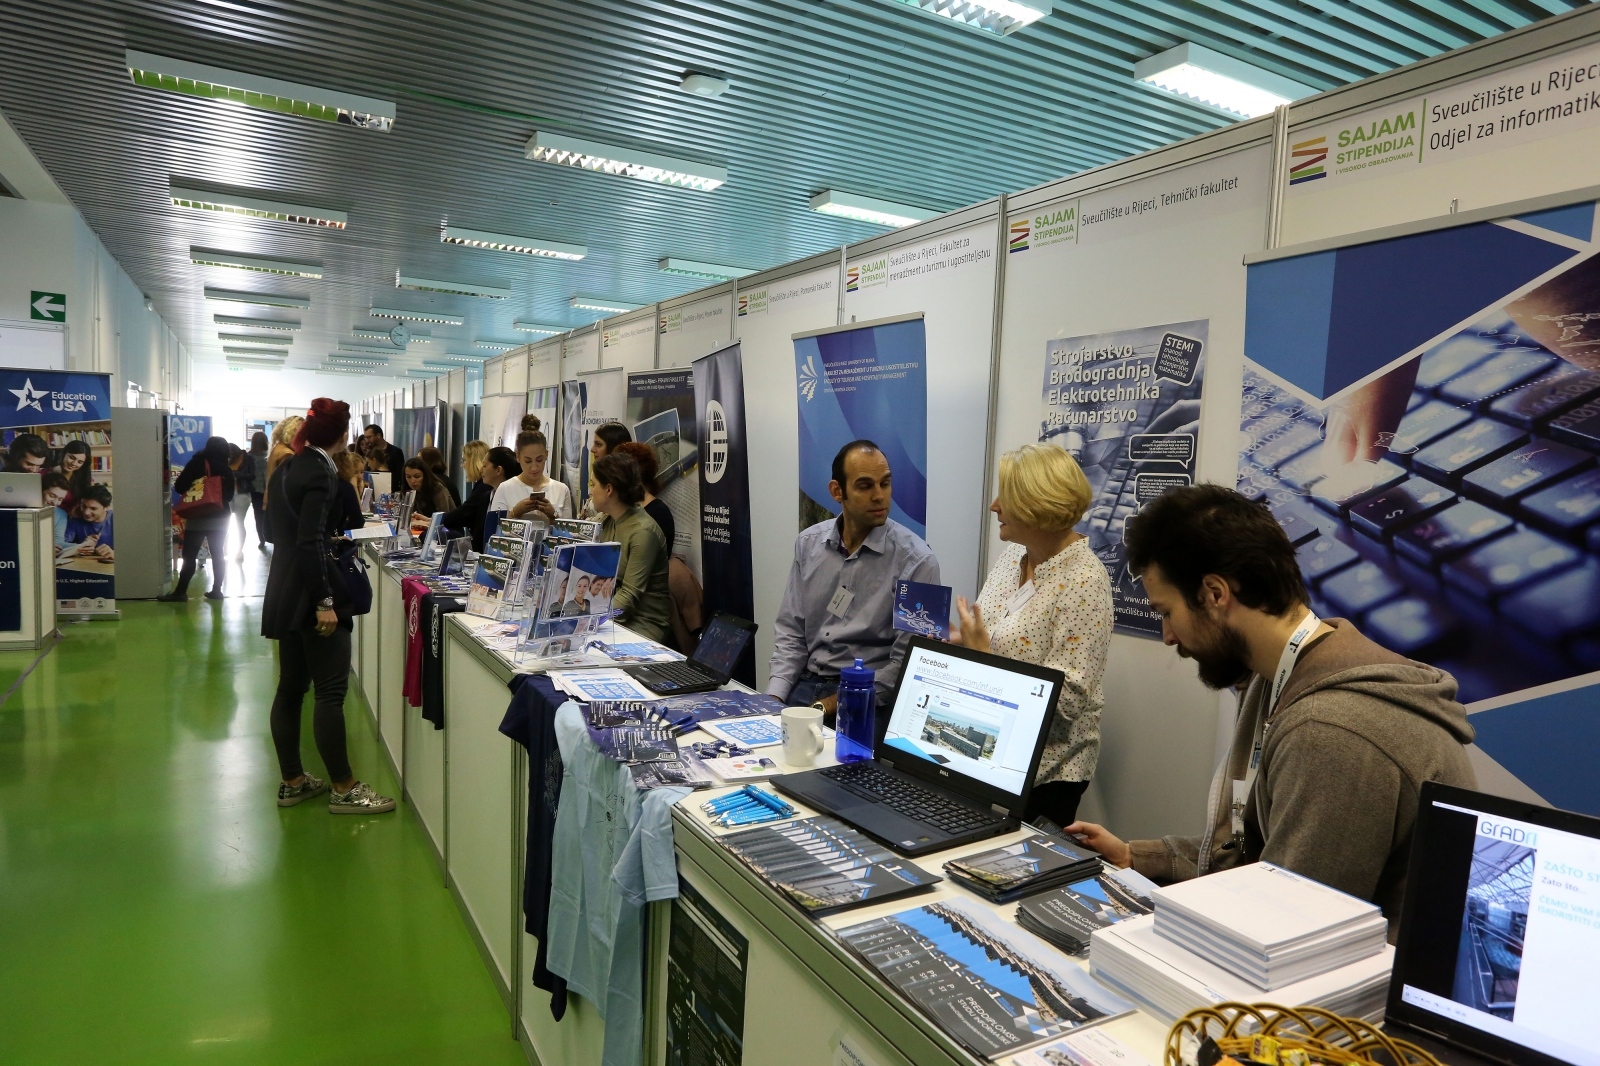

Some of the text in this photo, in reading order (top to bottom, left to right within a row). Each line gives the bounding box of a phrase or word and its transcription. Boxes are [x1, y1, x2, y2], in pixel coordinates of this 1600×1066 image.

[1432, 84, 1524, 123] Sveučilište
[1531, 80, 1541, 95] u
[1338, 112, 1415, 147] SAJAM
[1430, 124, 1472, 150] Odjel
[1476, 122, 1494, 138] za
[1336, 135, 1414, 164] STIPENDIJA
[1339, 162, 1367, 174] VISOKOG
[1368, 152, 1413, 167] OBRAZOVANJA
[1082, 176, 1238, 226] Sveučilište u Rijeci, Tehnički fakultet
[1035, 208, 1074, 229] SAJAM
[1034, 224, 1074, 241] STIPENDIJA
[940, 240, 962, 253] Fakultet
[861, 272, 885, 283] STIPENDIJA
[862, 259, 886, 275] SAJAM
[1050, 344, 1134, 366] Strojarstvo
[1165, 337, 1194, 352] STEM!
[1050, 360, 1150, 385] Brodogradnja
[52, 391, 96, 401] Education
[1049, 382, 1160, 405] Elektrotehnika
[52, 400, 87, 412] USA
[1047, 407, 1137, 425] Računarstvo
[1543, 861, 1583, 878] ZAŠTO
[1542, 876, 1562, 887] Zato
[966, 996, 1020, 1042] PREDDIPLOMSKI
[974, 1016, 1011, 1045] INFORMATIKE
